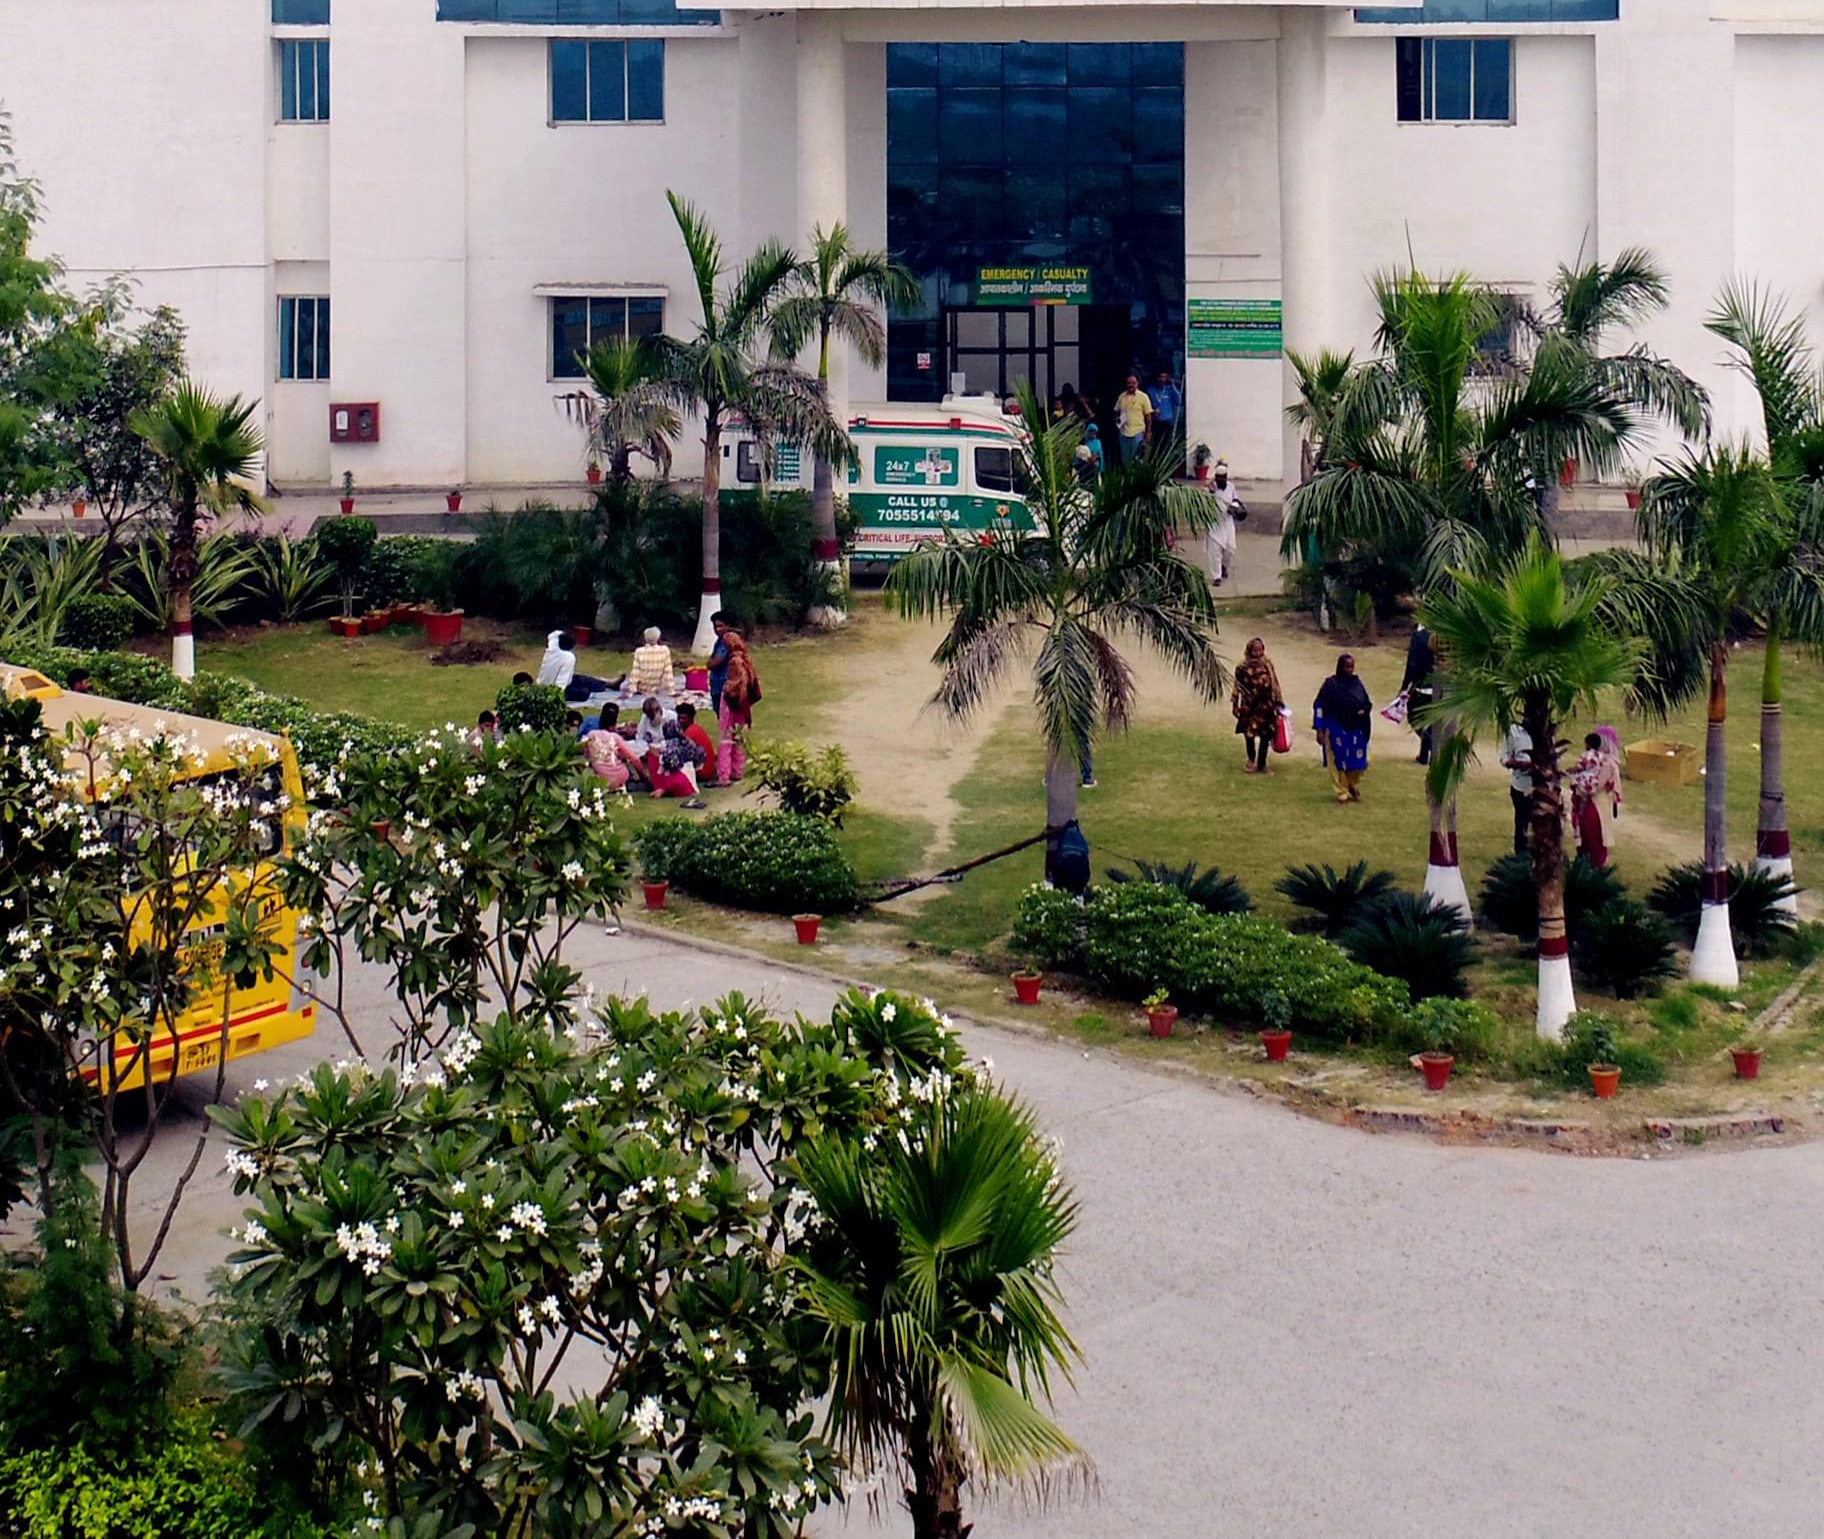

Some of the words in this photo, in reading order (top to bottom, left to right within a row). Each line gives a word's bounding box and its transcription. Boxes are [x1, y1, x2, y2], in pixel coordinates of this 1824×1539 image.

[981, 268, 1035, 279] EMERGENCY
[1042, 268, 1088, 279] CASUALTY
[888, 496, 918, 507] CALL
[920, 497, 937, 508] US
[895, 533, 910, 543] LIFE
